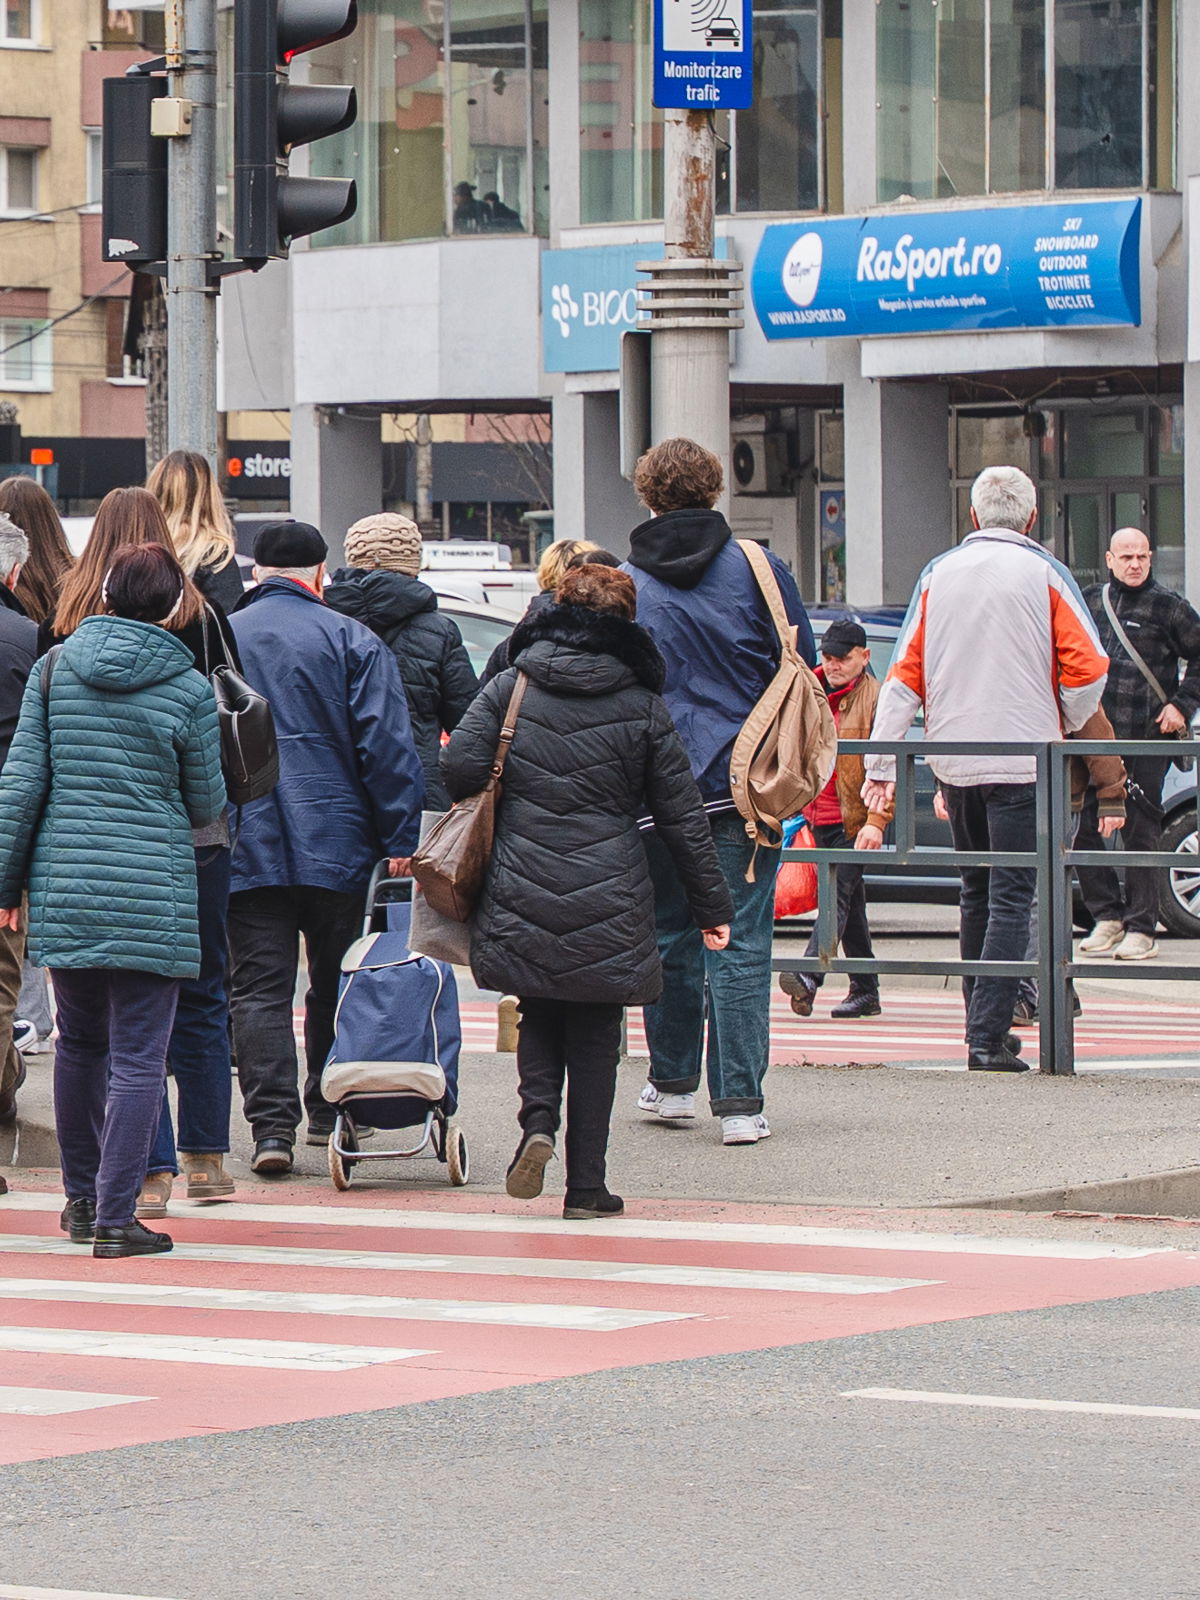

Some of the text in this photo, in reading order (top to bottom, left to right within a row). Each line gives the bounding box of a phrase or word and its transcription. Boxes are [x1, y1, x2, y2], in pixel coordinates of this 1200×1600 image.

[664, 61, 742, 78] Monitorizare
[686, 84, 720, 101] trafic
[1063, 218, 1082, 231] SKI
[1034, 235, 1099, 252] SNOWBOARD
[857, 234, 1002, 292] RaSport.ro
[1039, 255, 1088, 271] OUTDOOR
[1038, 275, 1091, 291] TROTINETE
[878, 298, 906, 313] Magazin
[912, 296, 935, 309] service
[935, 295, 960, 308] articole
[959, 293, 987, 309] sportive
[1045, 295, 1095, 310] BICICLETE
[768, 308, 846, 326] WWW.RASPORT.RO
[244, 453, 292, 477] store
